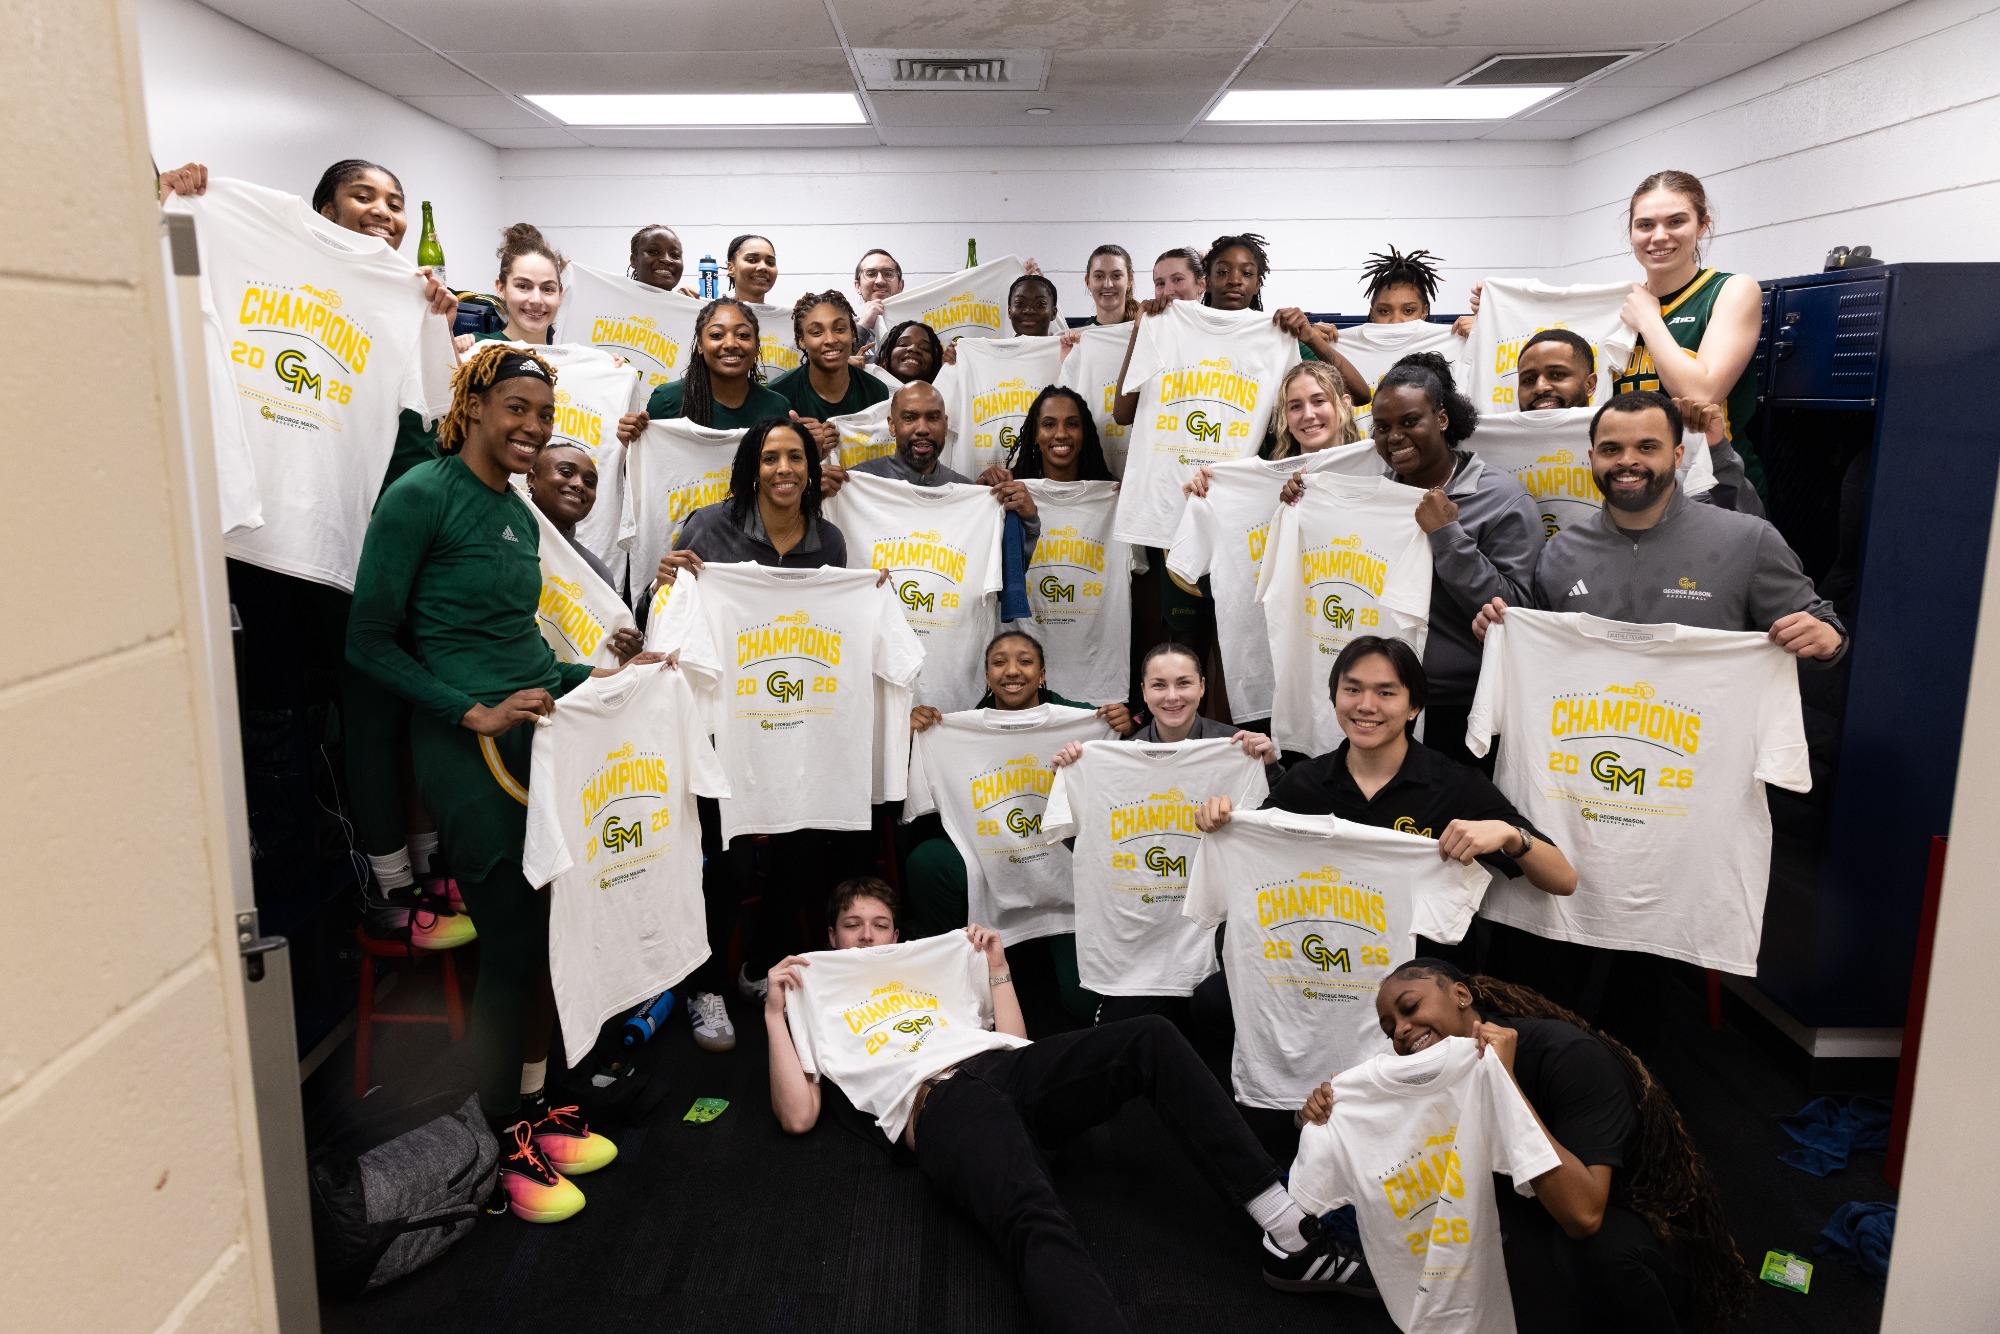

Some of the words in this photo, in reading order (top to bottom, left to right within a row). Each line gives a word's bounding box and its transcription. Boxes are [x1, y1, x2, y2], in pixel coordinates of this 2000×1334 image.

[239, 287, 371, 375] CHAMPIONS
[923, 303, 1001, 331] CHAMPIONS
[591, 319, 679, 369] CHAMPIONS
[231, 341, 265, 369] 20
[275, 349, 321, 401] GM
[326, 380, 353, 405] 26
[1160, 370, 1258, 412] CHAMPIONS
[1492, 386, 1514, 403] 20
[276, 414, 300, 425] GEORGE
[1156, 414, 1179, 431] 20
[1186, 410, 1222, 443] GM
[1227, 421, 1251, 438] 26
[974, 434, 992, 448] 20
[871, 539, 967, 585] CHAMPIONS
[1303, 551, 1387, 597] CHAMPIONS
[900, 580, 935, 613] GM
[940, 592, 960, 609] 26
[1040, 575, 1074, 603] GM
[1082, 582, 1103, 597] 26
[1323, 594, 1355, 631] GM
[1360, 607, 1379, 626] 26
[737, 626, 842, 667] CHAMPIONS
[736, 678, 757, 696] 20
[766, 670, 804, 703] GM
[812, 677, 838, 693] 26
[1551, 699, 1701, 755] CHAMPIONS
[1549, 751, 1579, 775] 20
[1590, 750, 1646, 795] GM
[1658, 767, 1694, 789] 26
[582, 758, 668, 828] CHAMPIONS
[586, 836, 597, 862] 20
[602, 816, 642, 852] GM
[651, 807, 670, 832] 26
[976, 820, 1000, 836] 20
[1598, 814, 1622, 822] GEORGE
[1112, 853, 1137, 870] 20
[1145, 846, 1186, 878] GM
[1257, 885, 1387, 934] CHAMPIONS
[1263, 941, 1293, 960] 20
[1301, 934, 1351, 973] GM
[1360, 945, 1390, 966] 26
[865, 1031, 889, 1056] 20
[1432, 1217, 1470, 1244] 26
